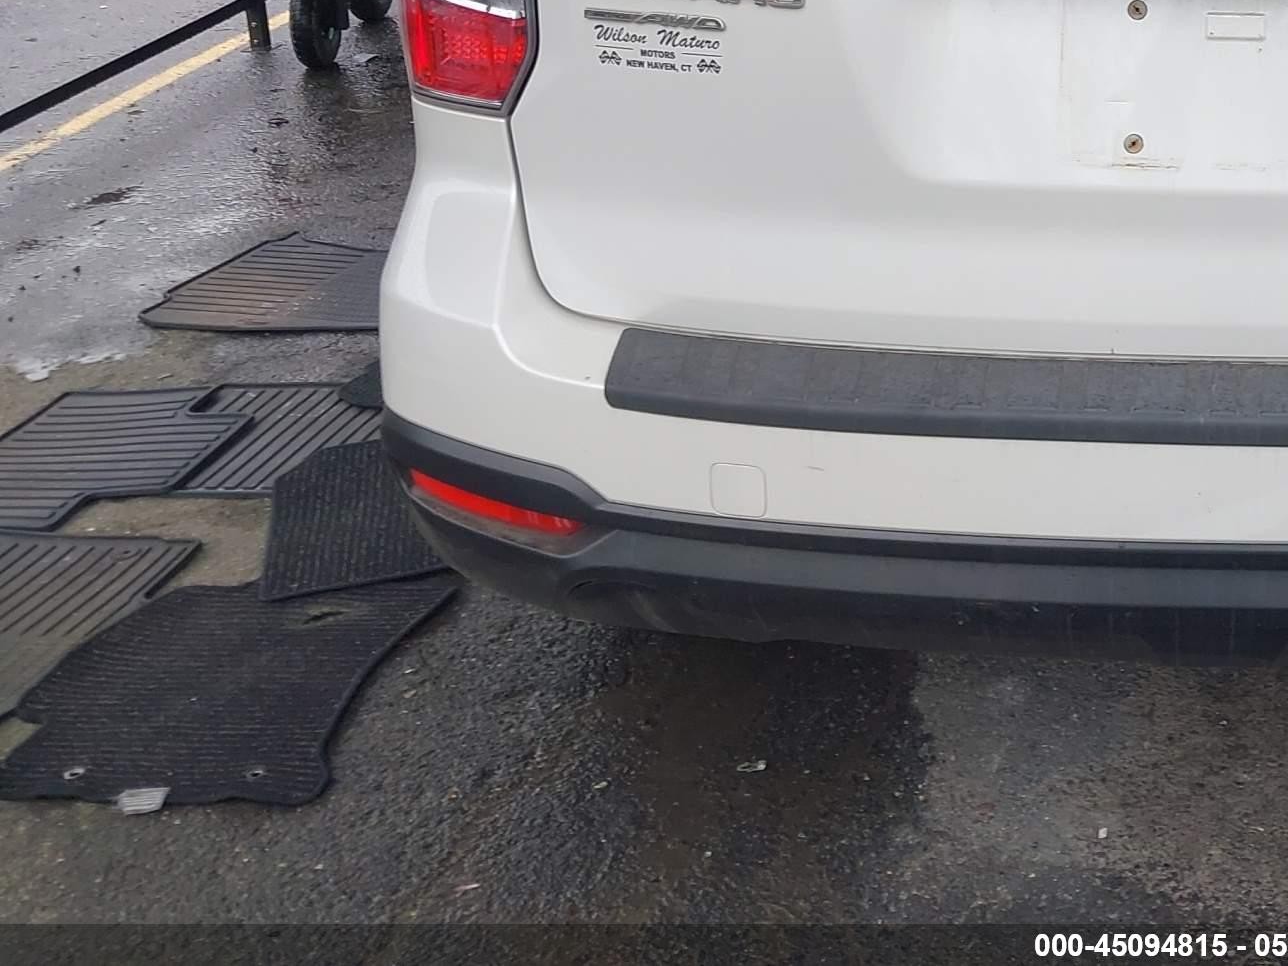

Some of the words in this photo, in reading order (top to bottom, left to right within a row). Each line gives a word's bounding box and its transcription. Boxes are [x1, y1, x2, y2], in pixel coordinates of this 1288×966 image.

[593, 24, 648, 44] Wilson
[657, 29, 721, 50] Maturo
[640, 49, 677, 60] MOTORS
[626, 59, 645, 69] NEW
[646, 60, 680, 73] HAVEN,
[681, 63, 693, 73] CT
